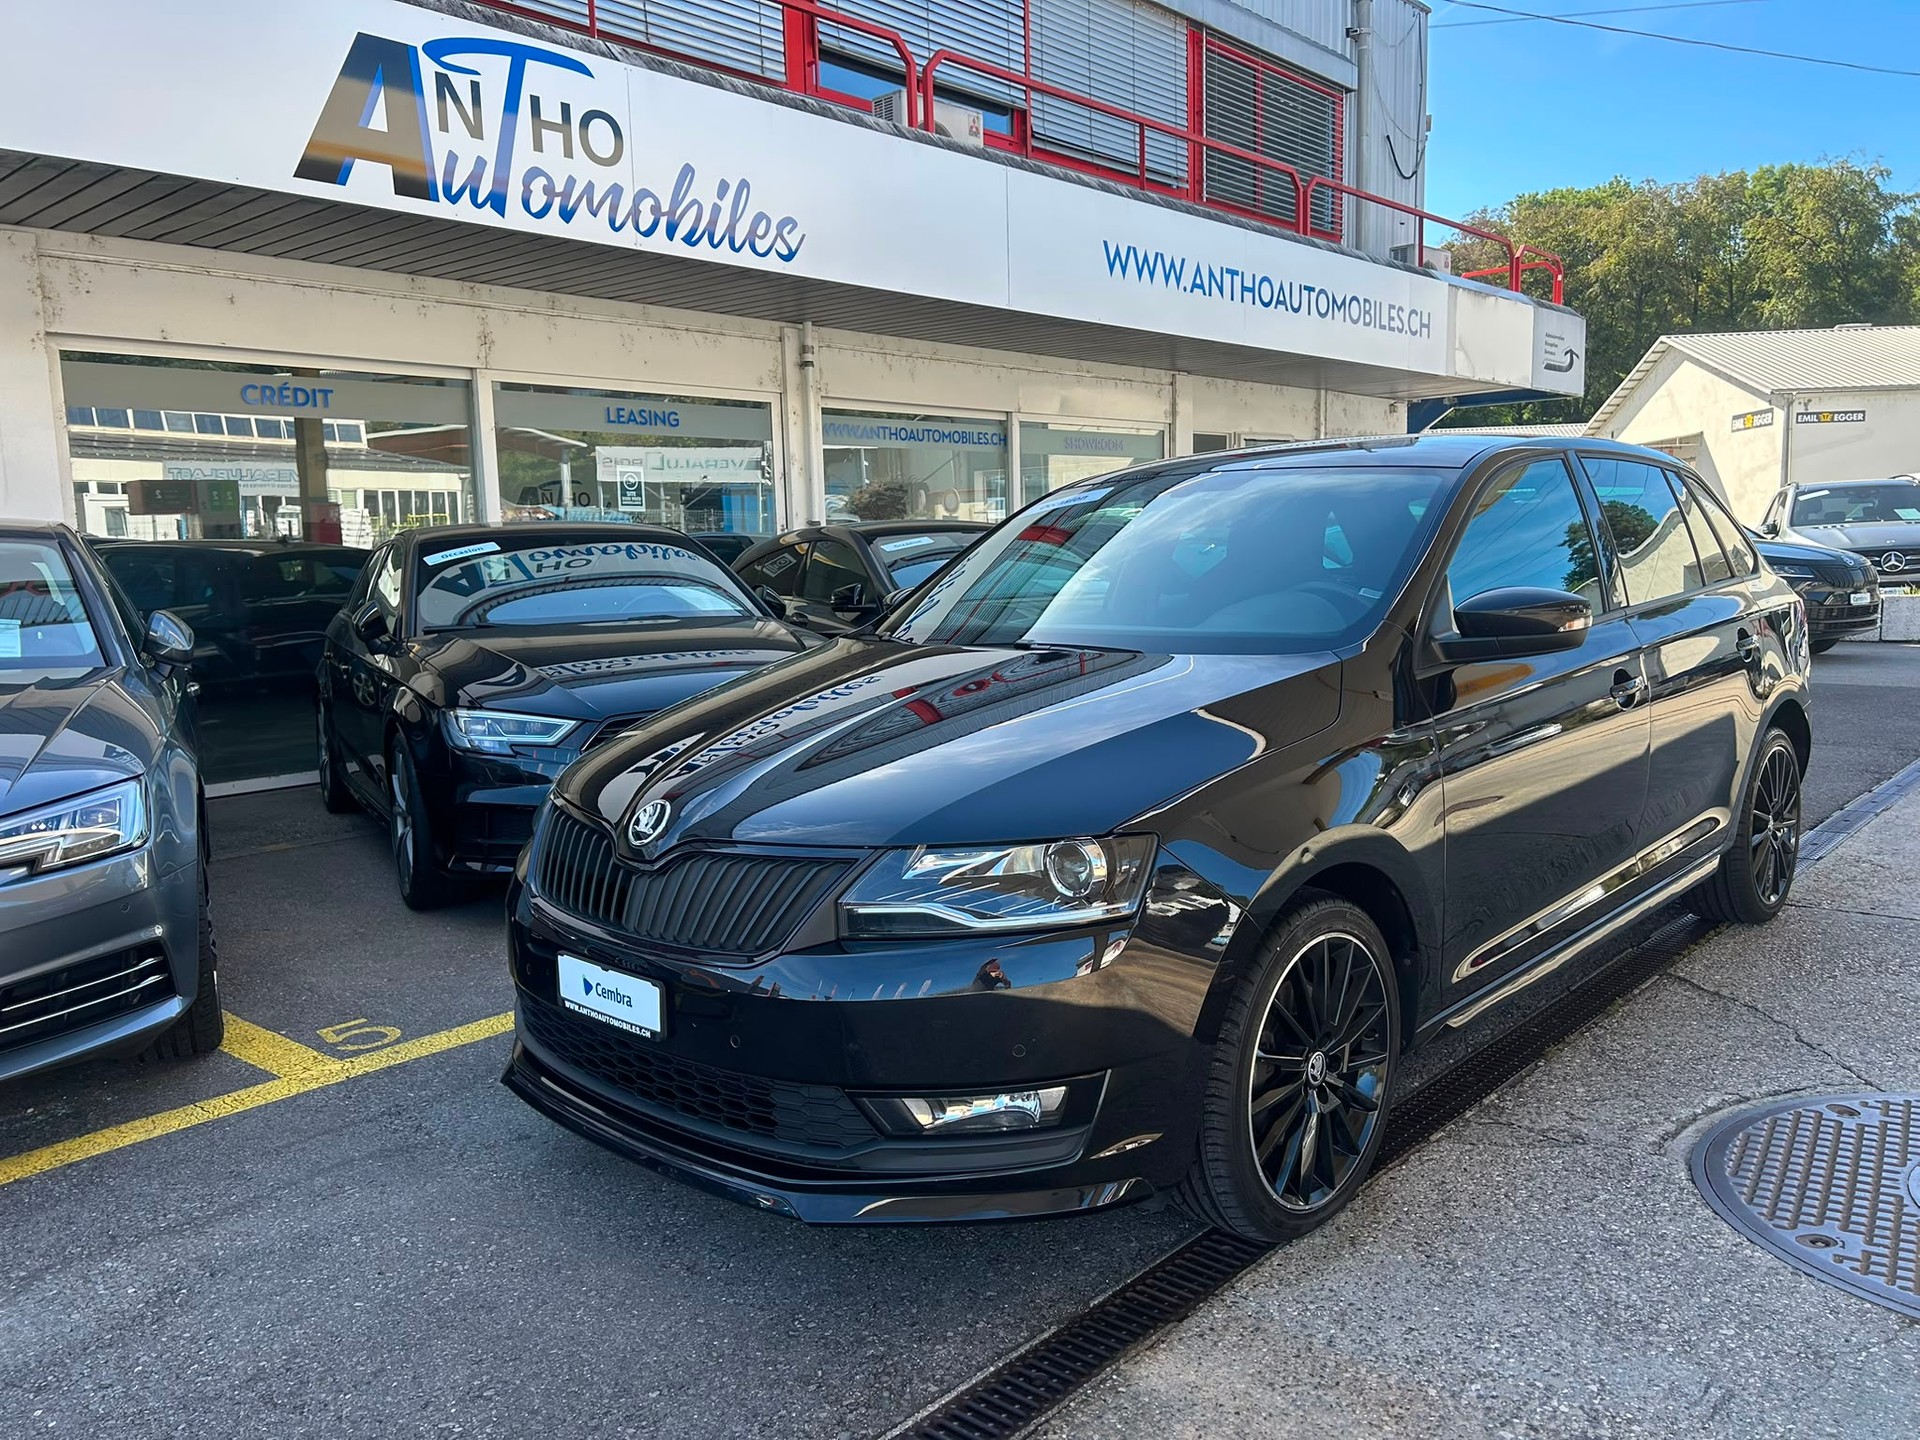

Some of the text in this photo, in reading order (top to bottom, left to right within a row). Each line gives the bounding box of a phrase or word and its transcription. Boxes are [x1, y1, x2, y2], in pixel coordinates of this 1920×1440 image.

[1102, 239, 1431, 339] WWW.ANTHOAUTOMOBILES.CH
[241, 382, 334, 408] CRÉDIT
[606, 407, 680, 427] LEASING
[1797, 412, 1864, 422] EMIL EGGER
[441, 547, 484, 559] Occasion
[595, 982, 633, 1008] Cembra
[564, 1000, 651, 1038] WWW.ANTHOAUTOMOBILES.CH
[316, 1017, 402, 1052] 5
